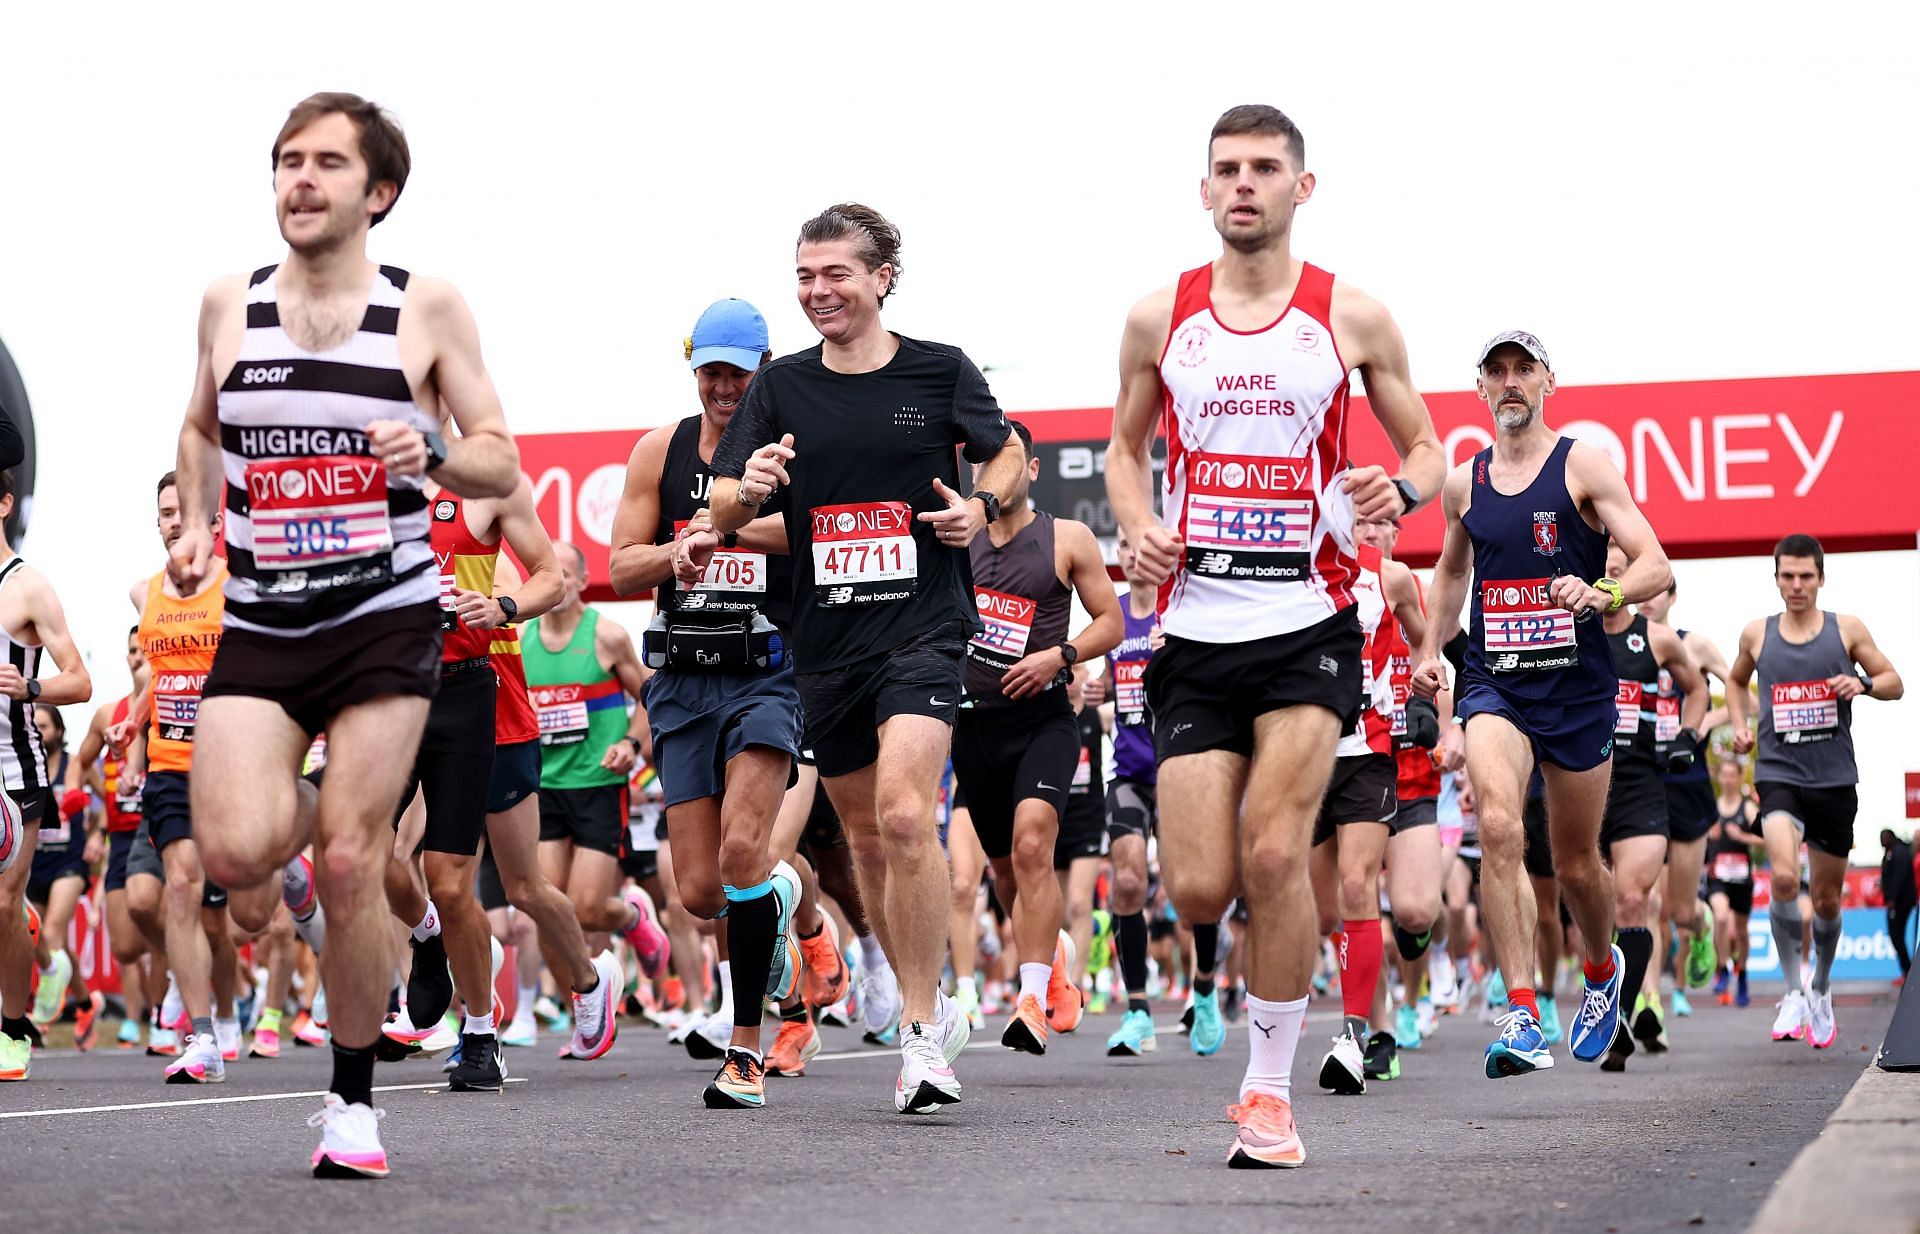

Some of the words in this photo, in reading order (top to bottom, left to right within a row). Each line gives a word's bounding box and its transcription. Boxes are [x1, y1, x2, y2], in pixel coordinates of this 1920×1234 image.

[242, 367, 294, 384] soar
[1216, 375, 1277, 391] WARE
[1199, 400, 1296, 418] JOGGERS
[240, 429, 374, 455] HIGHGAT
[1195, 460, 1307, 491] MONEY
[815, 509, 906, 534] MONEY
[1212, 506, 1287, 543] 1435
[284, 518, 350, 556] 905
[824, 543, 902, 575] 47711
[701, 560, 755, 585] 705
[1232, 567, 1254, 576] new
[1256, 566, 1299, 577] balance
[723, 601, 757, 610] balance
[854, 594, 872, 602] new
[873, 591, 910, 602] balance
[156, 609, 208, 624] Andrew
[1500, 616, 1556, 643] 1122
[973, 654, 986, 663] new
[986, 657, 1008, 670] balanc
[1519, 660, 1535, 668] new
[1537, 657, 1569, 667] balance
